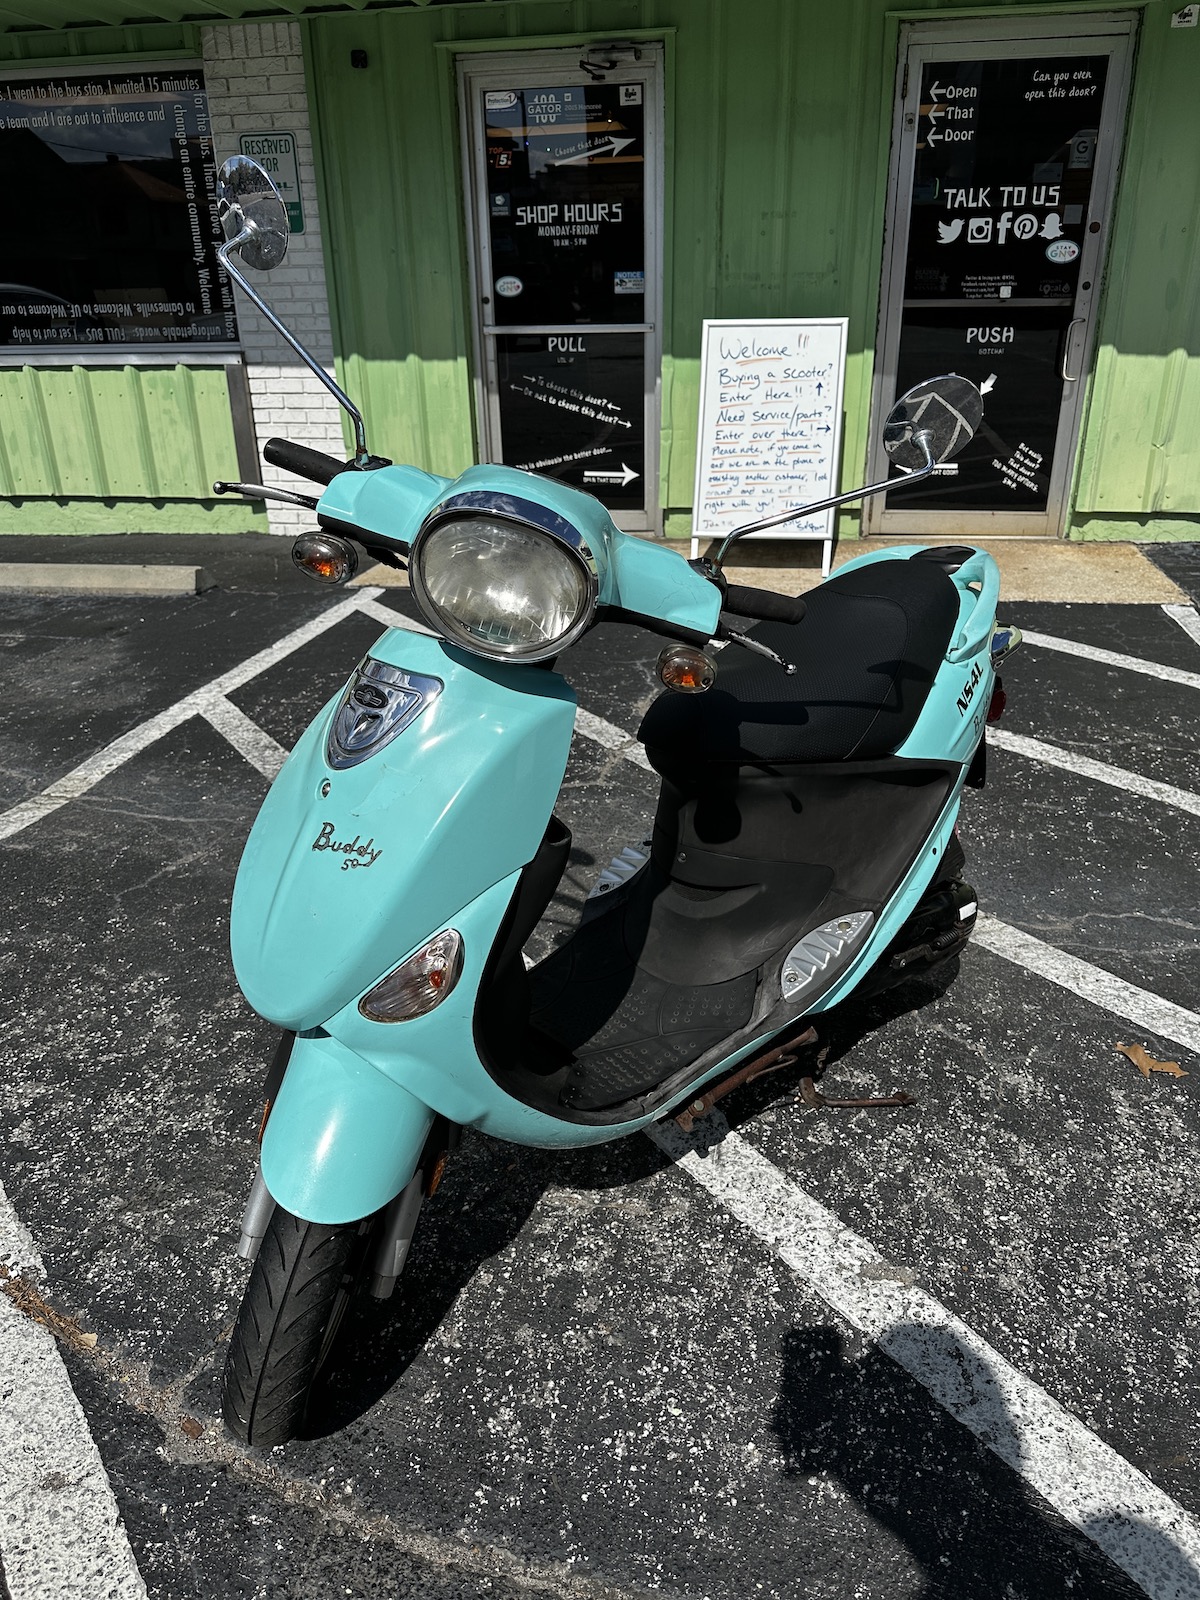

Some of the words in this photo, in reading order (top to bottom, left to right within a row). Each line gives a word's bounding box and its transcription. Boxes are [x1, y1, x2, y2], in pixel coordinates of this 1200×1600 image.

[1033, 70, 1051, 82] Can
[1054, 72, 1069, 87] you
[1073, 70, 1092, 81] even
[7, 85, 11, 100] I
[13, 86, 36, 99] went
[37, 85, 47, 98] to
[48, 81, 63, 98] the
[64, 80, 81, 97] bus
[83, 81, 107, 98] stop.
[108, 80, 113, 94] I
[113, 77, 145, 94] waited
[147, 77, 159, 92] 15
[162, 74, 200, 91] minutes
[946, 85, 977, 99] Open
[1025, 89, 1045, 101] open
[1048, 86, 1066, 98] this
[1068, 85, 1097, 97] door?
[193, 93, 207, 110] for
[527, 104, 562, 114] GATOR
[7, 115, 30, 129] team
[32, 110, 49, 127] and
[50, 111, 55, 126] I
[57, 114, 72, 126] are
[75, 112, 90, 125] out
[91, 111, 101, 124] to
[103, 106, 145, 123] influence
[147, 105, 165, 122] and
[946, 106, 974, 119] That
[174, 104, 187, 145] change
[196, 113, 210, 131] the
[944, 129, 974, 142] Door
[199, 135, 212, 159] bus.
[244, 139, 291, 155] RESERVED
[577, 139, 592, 150] that
[180, 149, 190, 163] an
[260, 157, 279, 172] FOR
[203, 161, 216, 189] Then
[182, 167, 196, 199] entire
[943, 187, 990, 209] TALK
[1000, 186, 1027, 206] TO
[1032, 185, 1061, 207] US
[208, 202, 221, 235] drove
[515, 204, 559, 226] SHOP
[564, 203, 622, 223] HOURS
[187, 202, 207, 266] community.
[537, 224, 599, 237] MONDAY-FRIDAY
[197, 268, 213, 315] Welcome
[220, 286, 235, 308] with
[2, 305, 15, 315] our
[17, 305, 27, 317] to
[28, 304, 67, 318] Welcome
[69, 303, 82, 318] UF.
[82, 303, 92, 316] to
[94, 302, 134, 317] Welcome
[136, 302, 184, 317] Gainesville.
[186, 302, 195, 313] to
[132, 327, 161, 338] words:
[162, 323, 222, 342] unforgettable
[224, 311, 236, 339] those
[12, 325, 31, 342] help
[32, 327, 42, 340] to
[43, 327, 58, 339] out
[59, 328, 72, 340] set
[966, 327, 1014, 343] PUSH
[548, 337, 586, 352] PULL
[718, 368, 761, 390] Buying
[546, 381, 568, 394] choose
[570, 388, 584, 401] this
[720, 392, 752, 403] Enter
[534, 392, 547, 402] not
[548, 395, 557, 405] to
[557, 398, 580, 413] choose
[580, 405, 596, 418] this
[716, 409, 745, 424] Need
[715, 430, 744, 440] Enter
[752, 431, 775, 439] over
[712, 446, 737, 455] Please
[767, 443, 776, 452] if
[775, 446, 788, 457] you
[528, 462, 535, 470] is
[563, 453, 574, 462] the
[573, 449, 592, 460] better
[710, 460, 725, 469] and
[774, 458, 789, 466] the
[792, 457, 814, 470] phone
[708, 473, 740, 487] assisting
[745, 472, 769, 481] another
[814, 472, 828, 481] look
[740, 487, 755, 495] and
[704, 501, 725, 515] right
[312, 822, 383, 867] Buddy
[341, 858, 360, 871] 50
